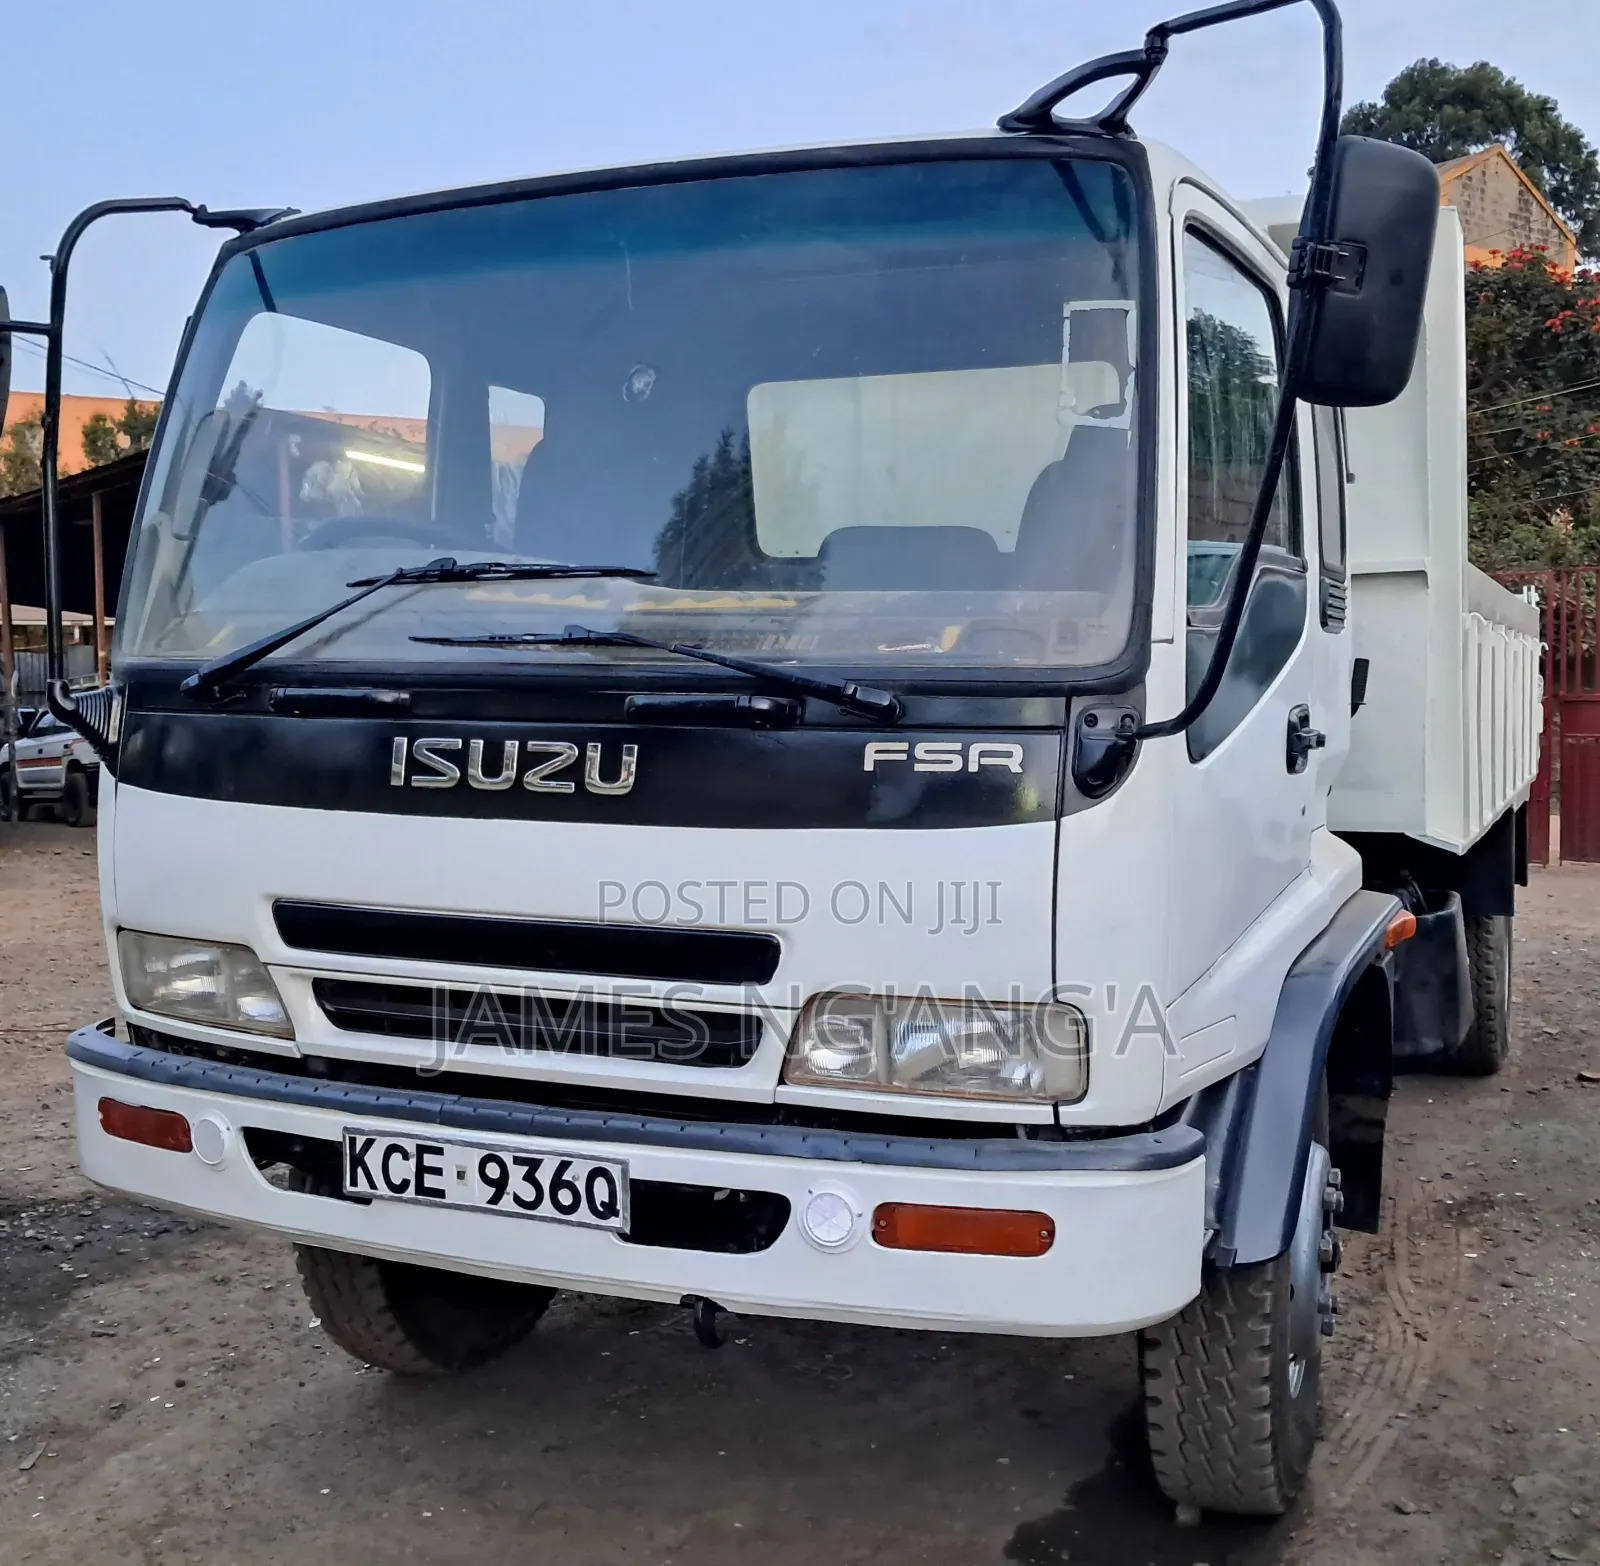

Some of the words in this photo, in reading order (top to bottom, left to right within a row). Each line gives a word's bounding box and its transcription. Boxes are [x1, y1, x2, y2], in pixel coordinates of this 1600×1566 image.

[390, 736, 639, 796] ISUZU
[863, 741, 1025, 774] FSR
[349, 1136, 447, 1200] KCE
[478, 1152, 620, 1221] 936Q
